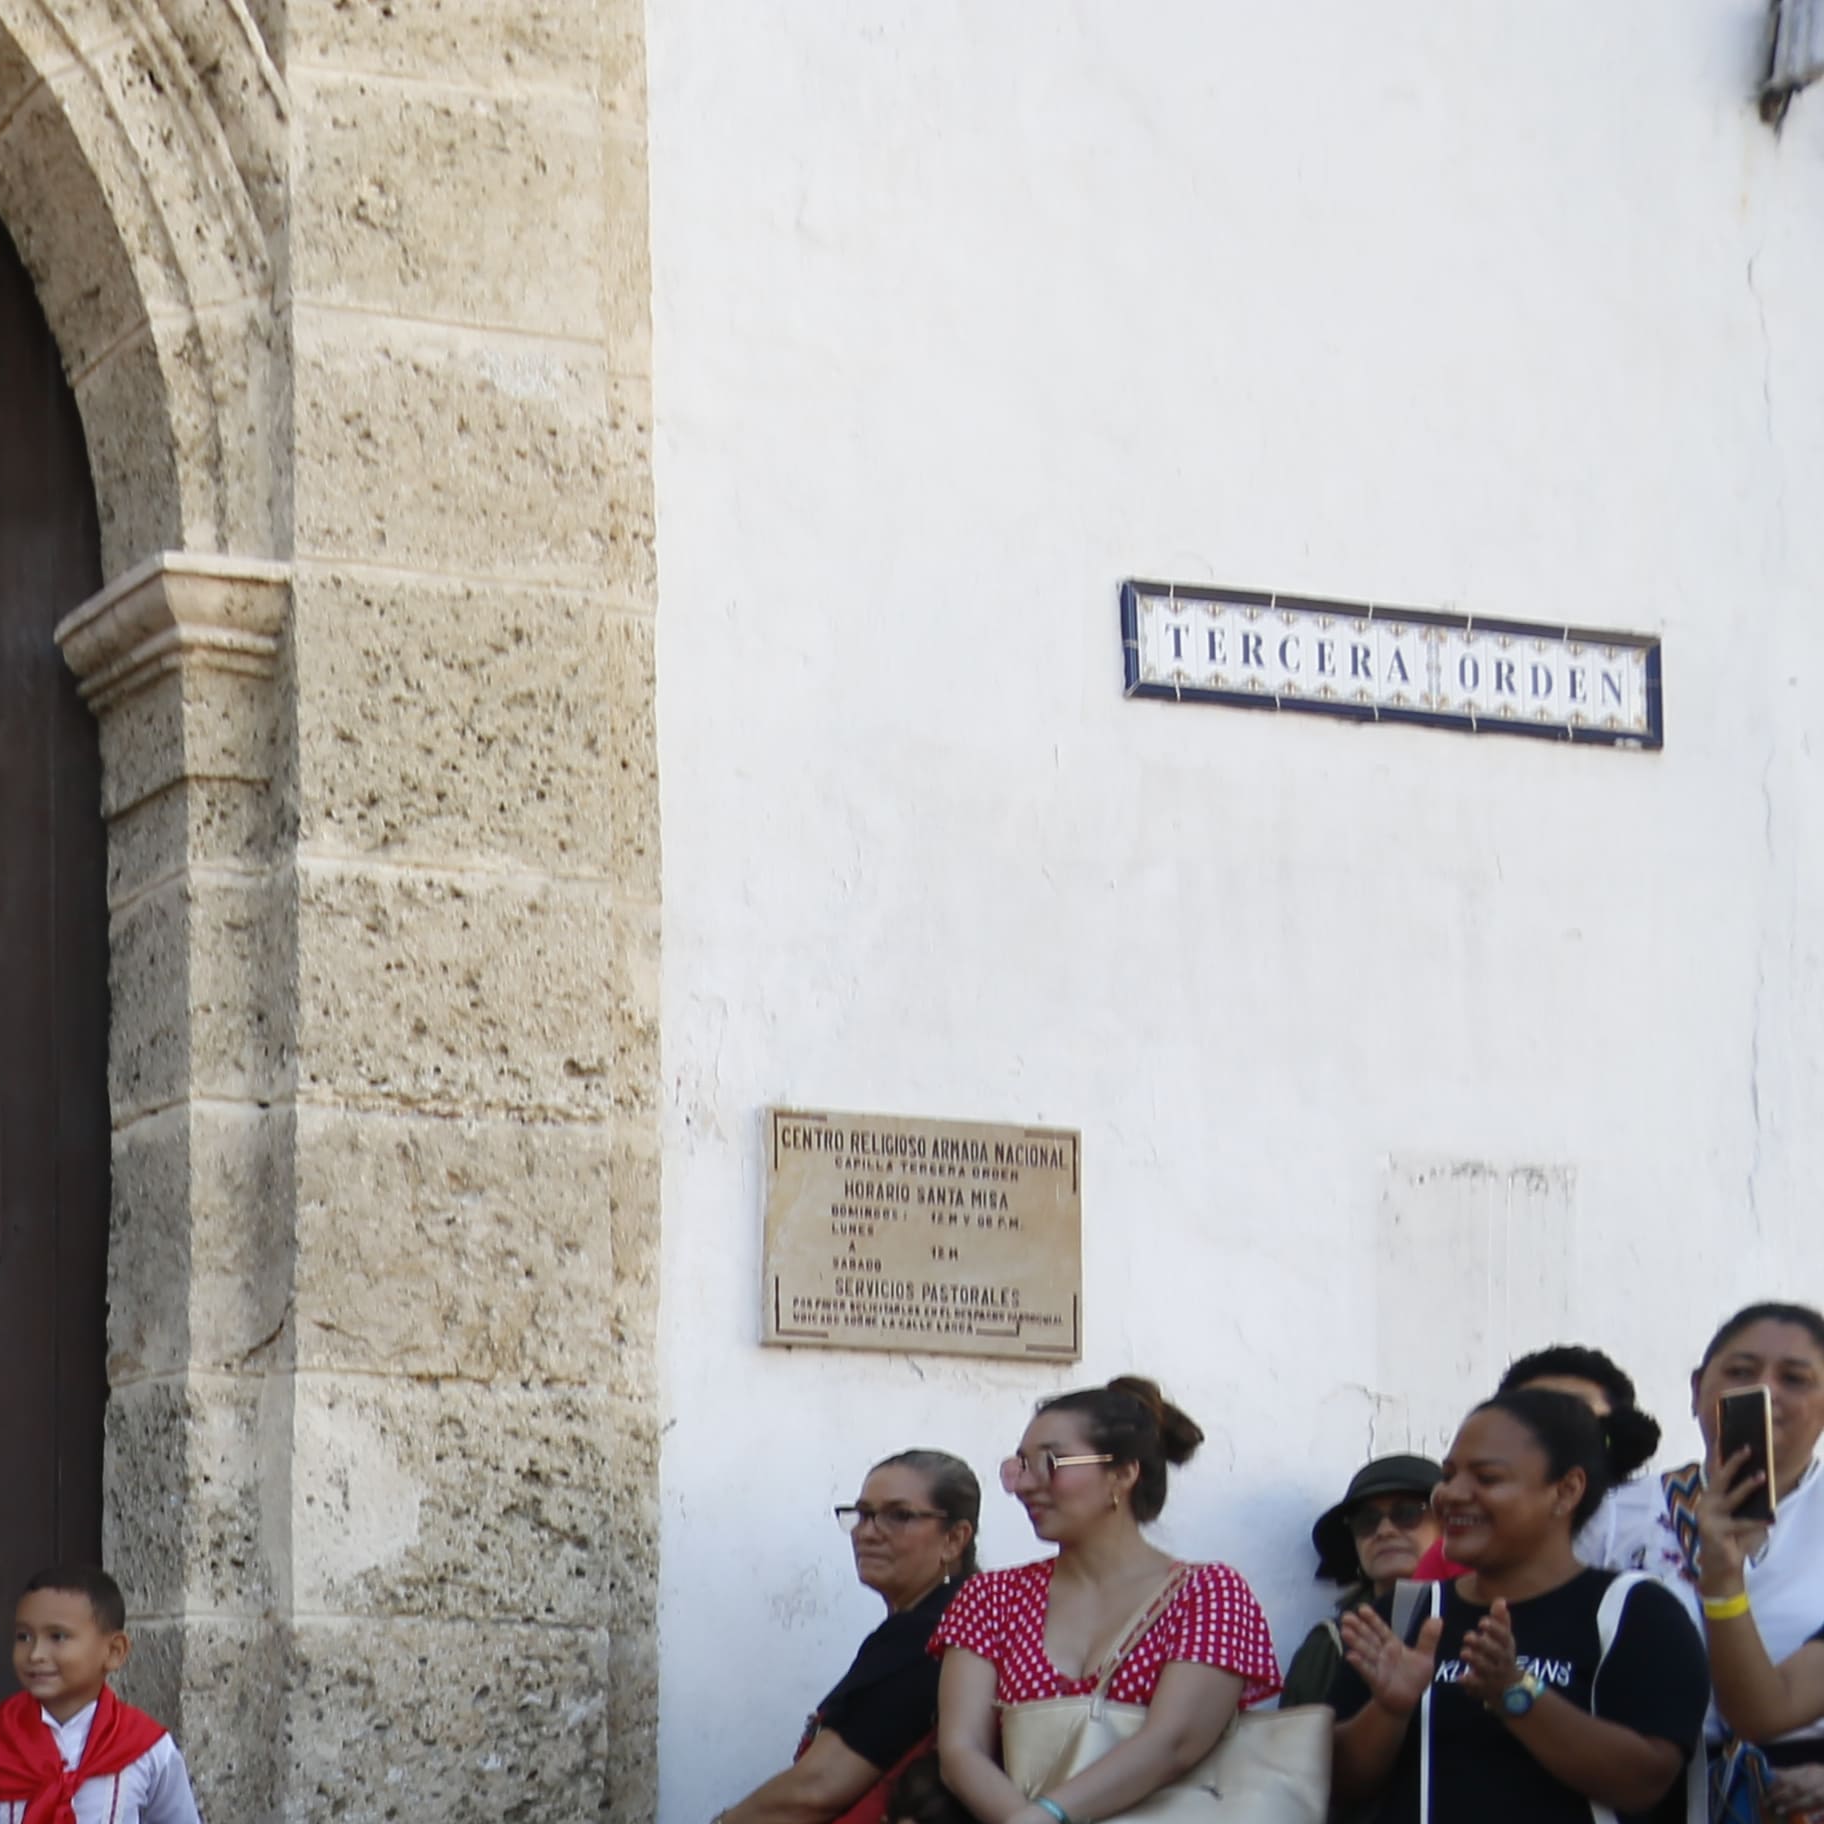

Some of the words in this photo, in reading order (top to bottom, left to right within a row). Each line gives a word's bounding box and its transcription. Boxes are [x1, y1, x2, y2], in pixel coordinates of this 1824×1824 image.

[1165, 623, 1409, 682] TERCERA
[1459, 654, 1623, 706] ORDEN
[782, 1126, 844, 1151] CENTRO
[851, 1130, 926, 1158] RELIGIOSO
[932, 1137, 988, 1163] ARMADA
[995, 1142, 1067, 1170] NACIONAL
[835, 1156, 893, 1172] CAPILLA
[902, 1161, 965, 1178] TERCERA
[972, 1166, 1018, 1182] ORDEN
[844, 1179, 910, 1202] HORARIO
[917, 1184, 963, 1206] SANTA
[971, 1189, 1008, 1211] MISA
[832, 1222, 874, 1236] LUNES
[849, 1240, 856, 1253] A
[833, 1256, 882, 1272] SABADO
[835, 1278, 914, 1300] SERVICIOS
[922, 1283, 1021, 1307] PASTORALES
